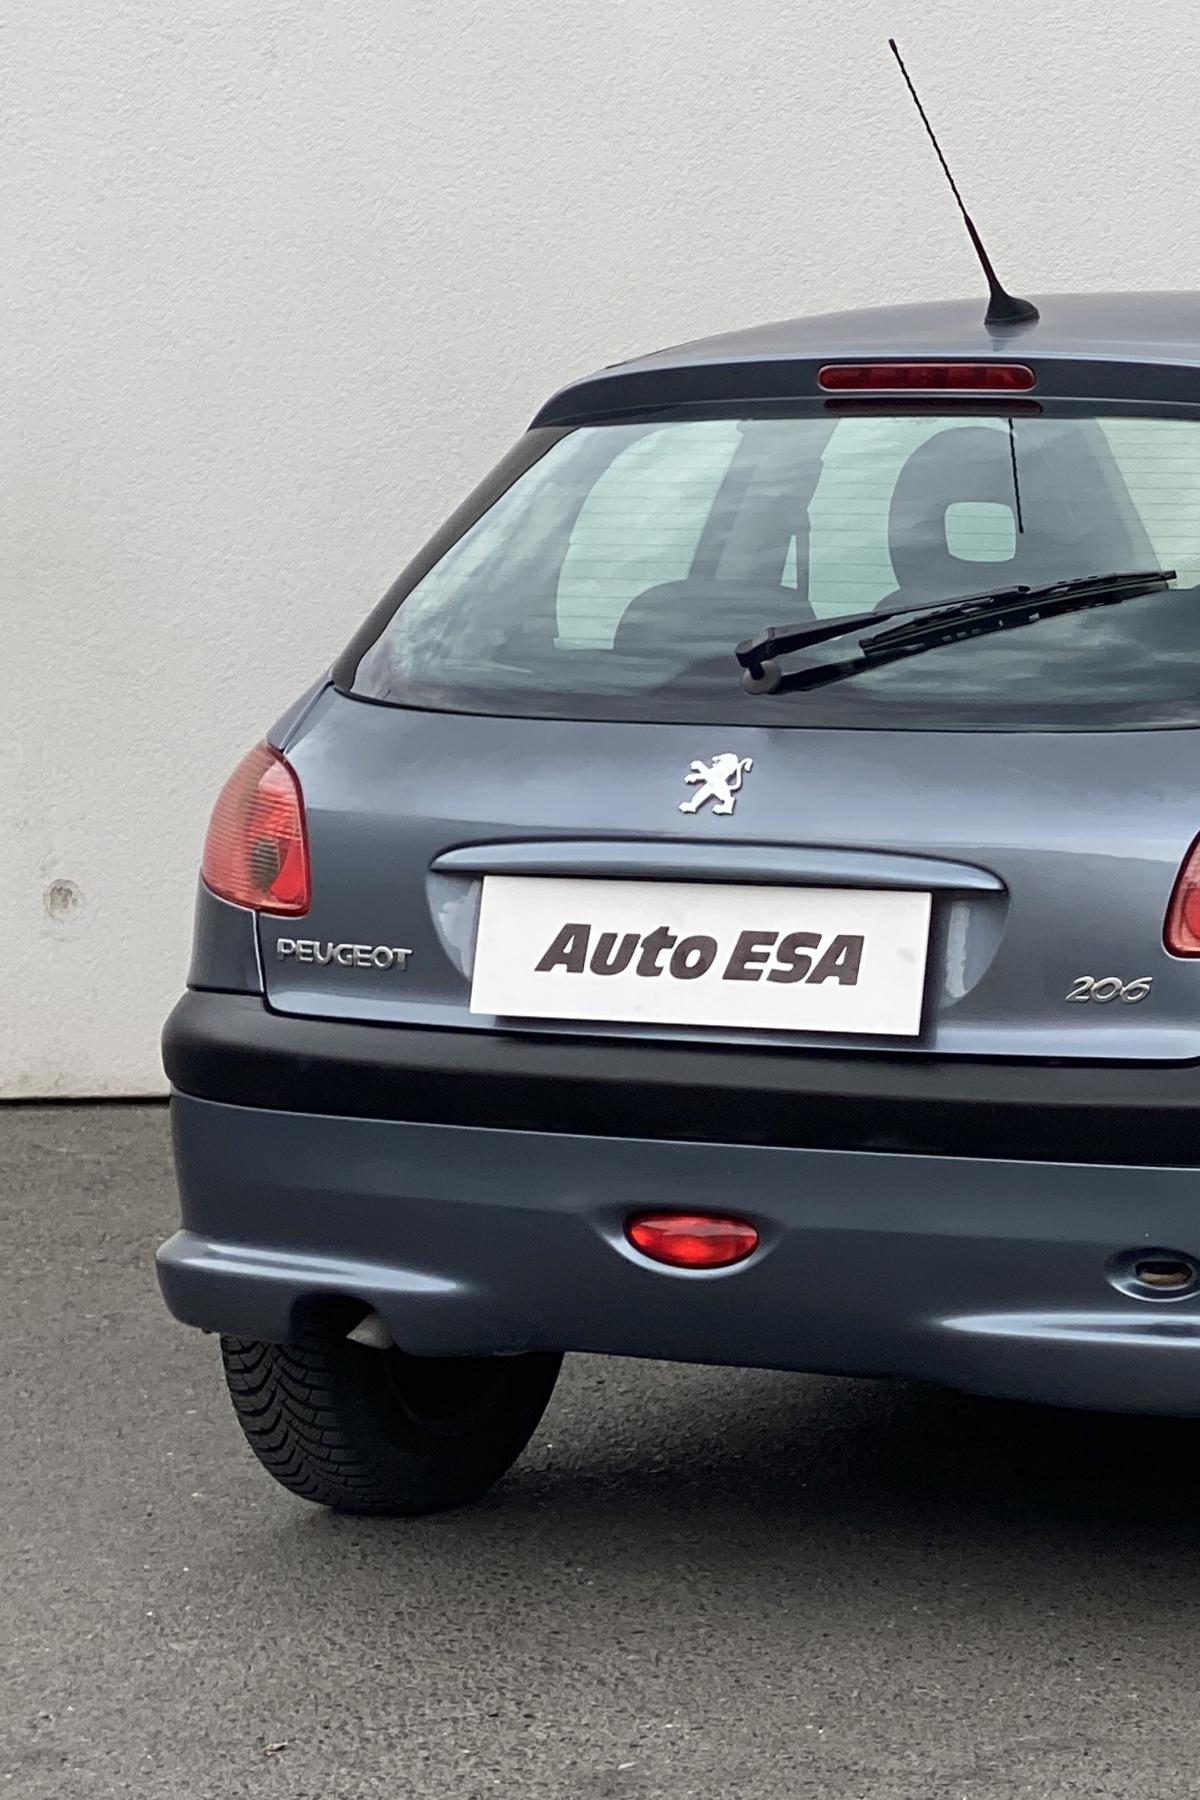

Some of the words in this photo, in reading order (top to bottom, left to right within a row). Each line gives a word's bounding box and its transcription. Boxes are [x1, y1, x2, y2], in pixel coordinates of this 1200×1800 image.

[276, 937, 413, 971] PEUGEOT
[535, 922, 718, 980] Auto
[722, 930, 865, 986] ESA
[1065, 975, 1154, 1004] 206
